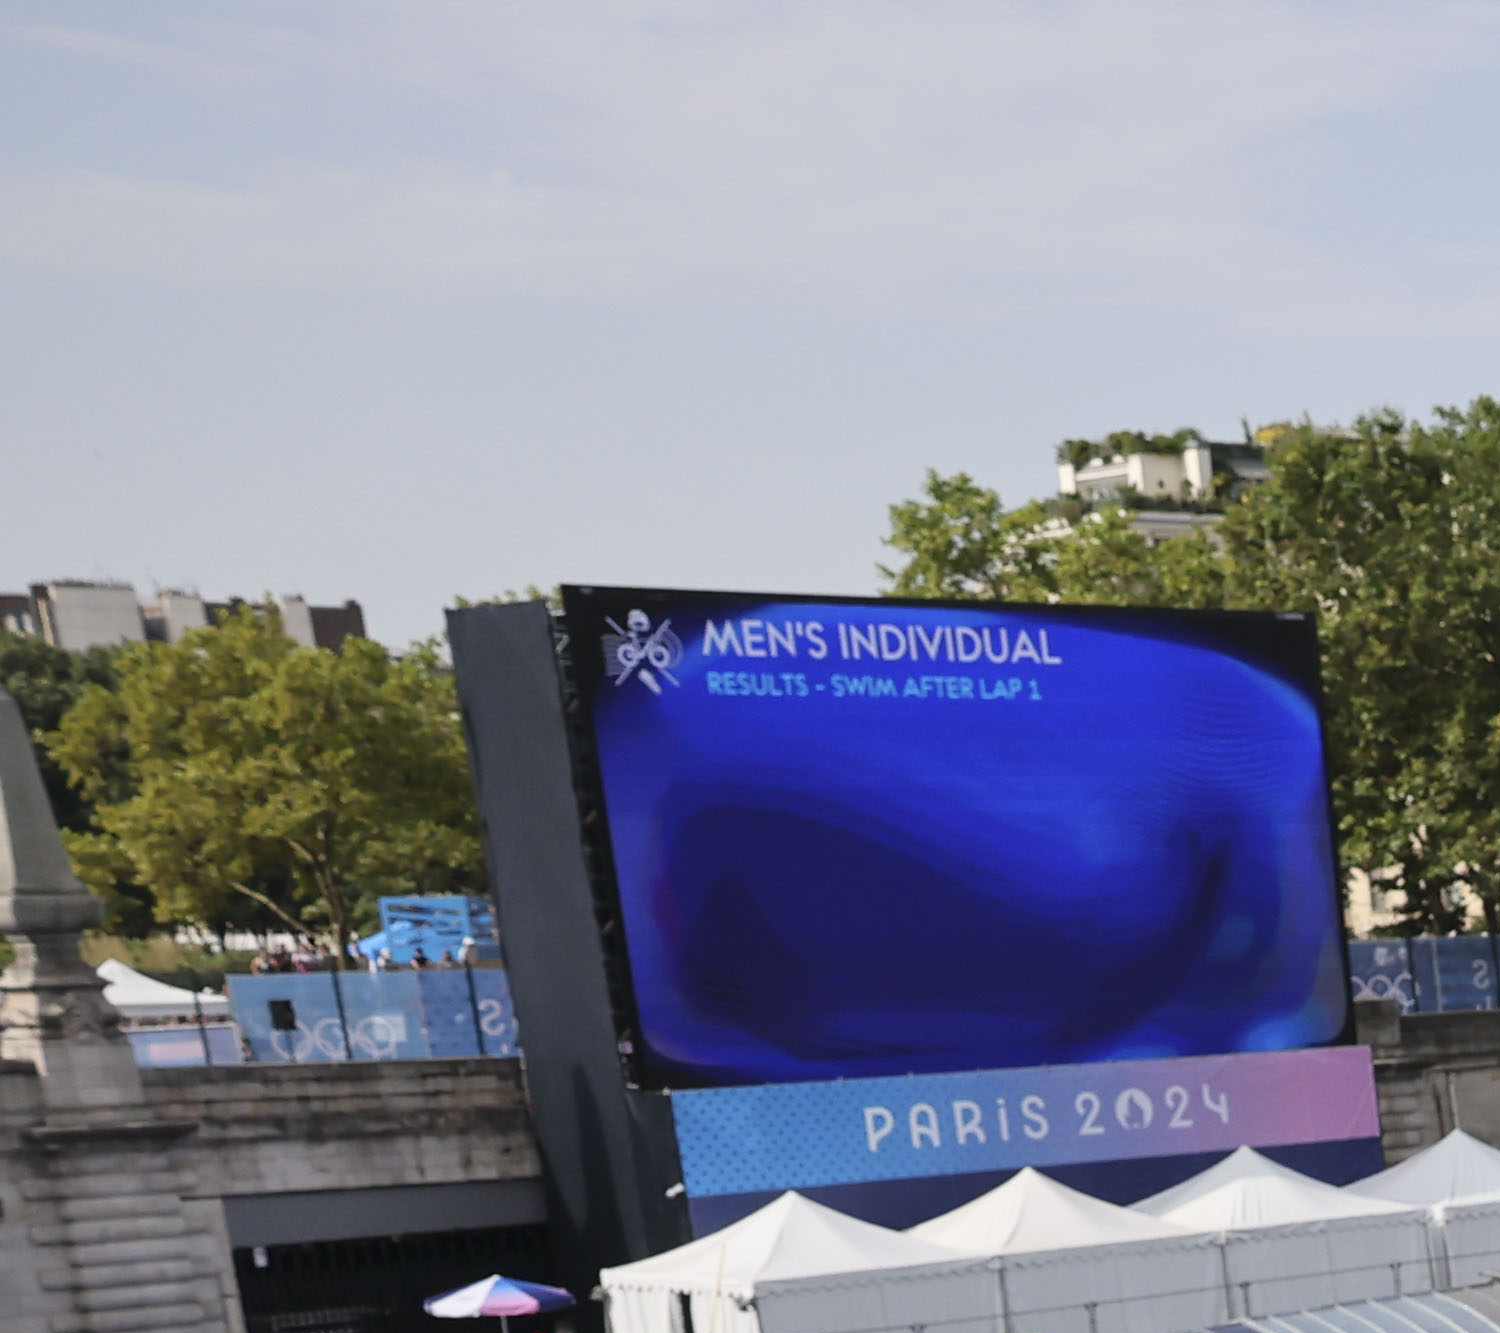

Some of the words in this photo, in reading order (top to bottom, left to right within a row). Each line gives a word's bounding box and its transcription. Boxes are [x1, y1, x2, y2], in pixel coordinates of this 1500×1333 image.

[702, 618, 828, 660] MEN'S
[838, 622, 1062, 664] INDIVIDUAL
[706, 670, 809, 697] RESULTS
[831, 673, 898, 698] SWIM
[903, 676, 974, 699] AFTER
[979, 678, 1022, 700] LAP
[1029, 678, 1042, 700] 1
[864, 1095, 1050, 1153] PARIS
[1073, 1083, 1230, 1137] 2024
